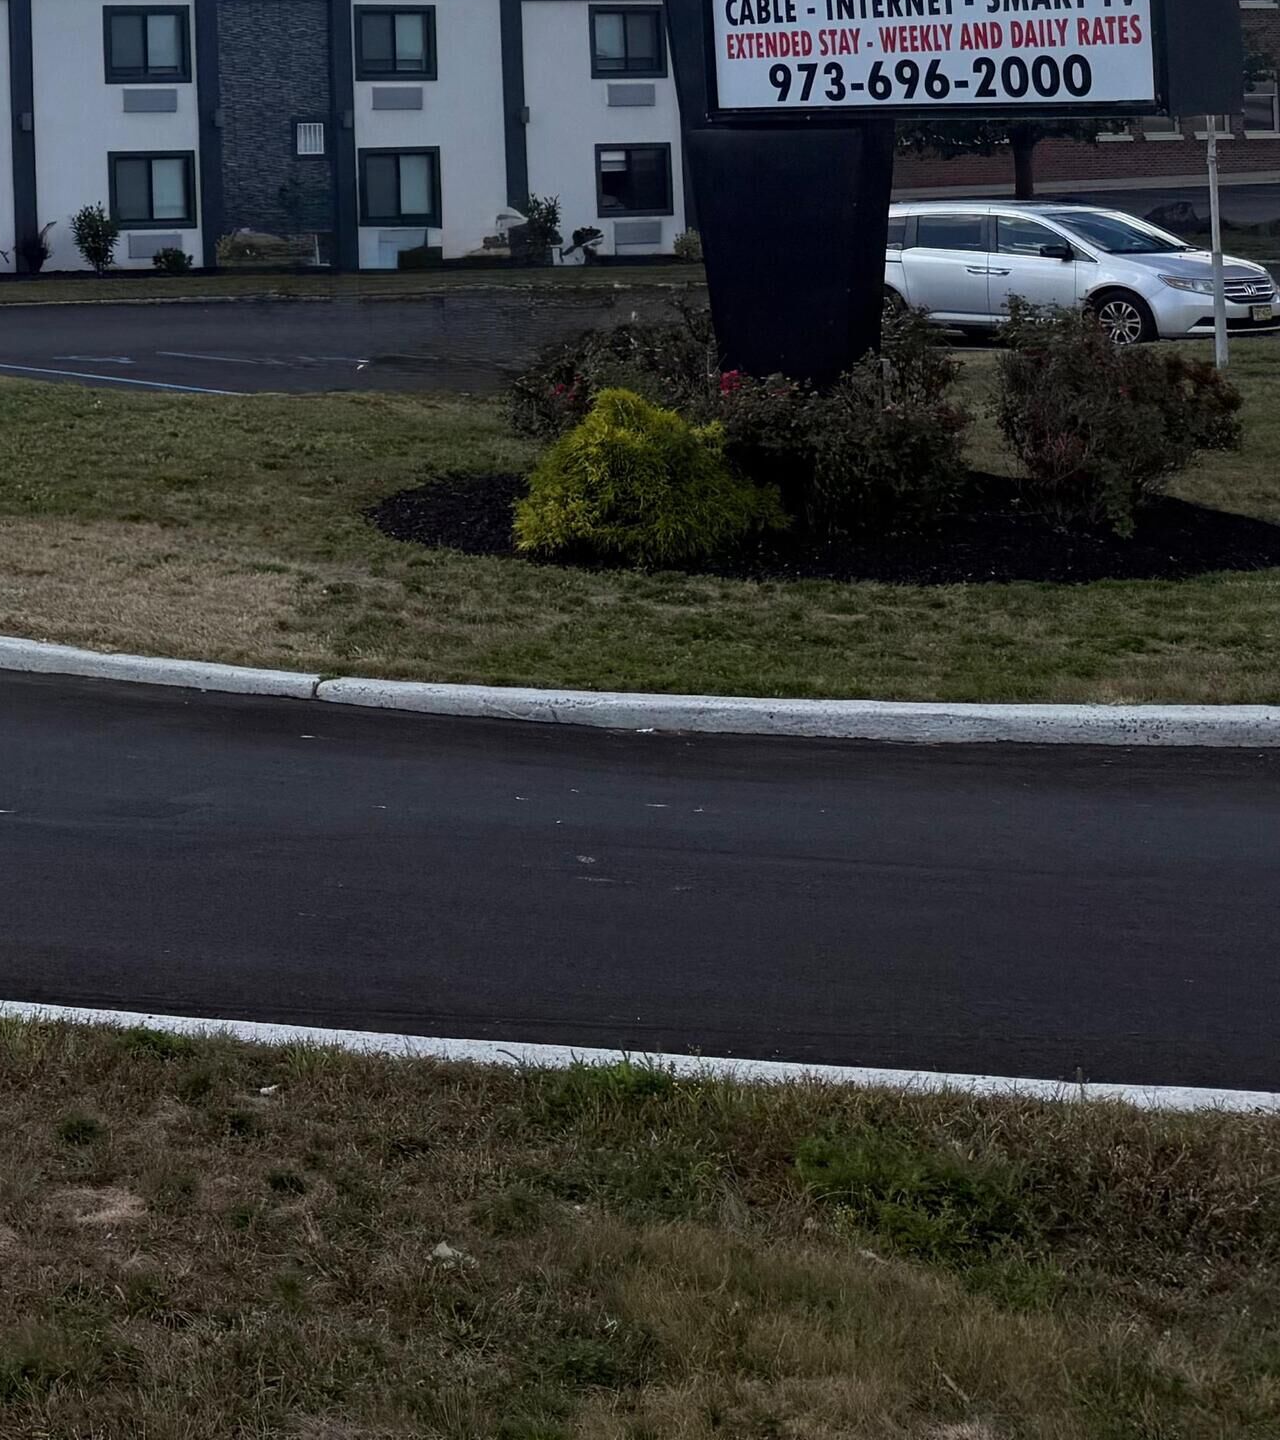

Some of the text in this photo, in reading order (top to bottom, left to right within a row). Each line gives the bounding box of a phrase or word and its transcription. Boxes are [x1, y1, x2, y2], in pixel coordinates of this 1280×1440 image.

[726, 30, 813, 60] EXTENDED
[818, 28, 861, 56] STAY
[879, 23, 953, 54] WEEKLY
[960, 21, 1003, 50] AND
[1010, 18, 1069, 49] DAILY
[1077, 14, 1142, 45] RATES
[768, 53, 1092, 102] 973-696-2000
